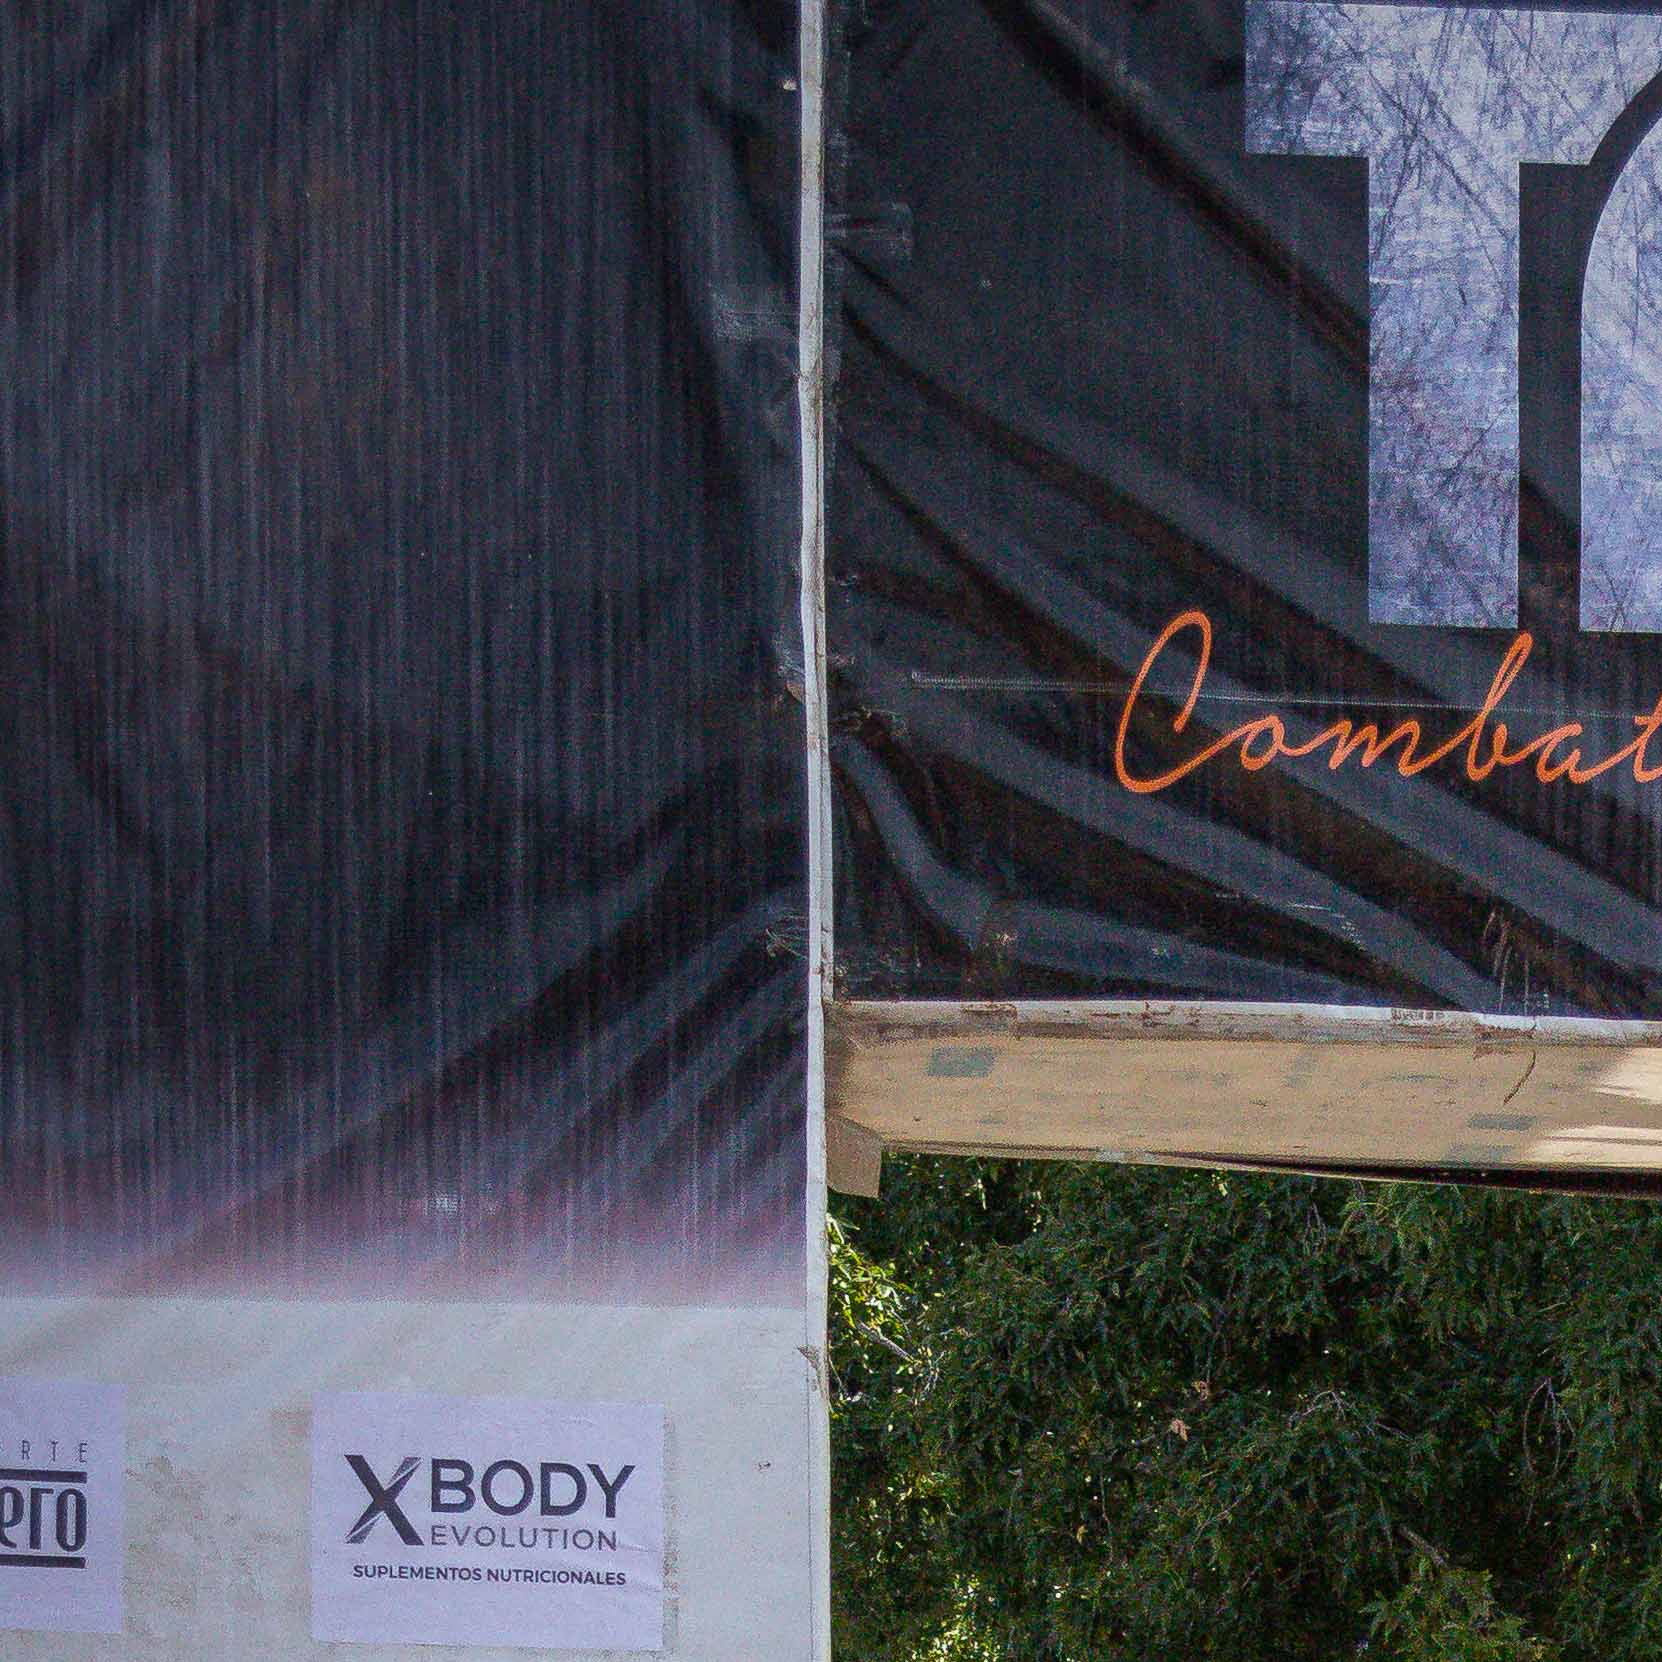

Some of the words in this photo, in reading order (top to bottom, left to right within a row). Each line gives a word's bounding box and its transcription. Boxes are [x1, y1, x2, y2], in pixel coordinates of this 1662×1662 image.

[430, 1524, 617, 1551] EVOLUTION
[353, 1564, 482, 1583] SUPLEMENTOS
[487, 1568, 626, 1586] NUTRICIONALES
